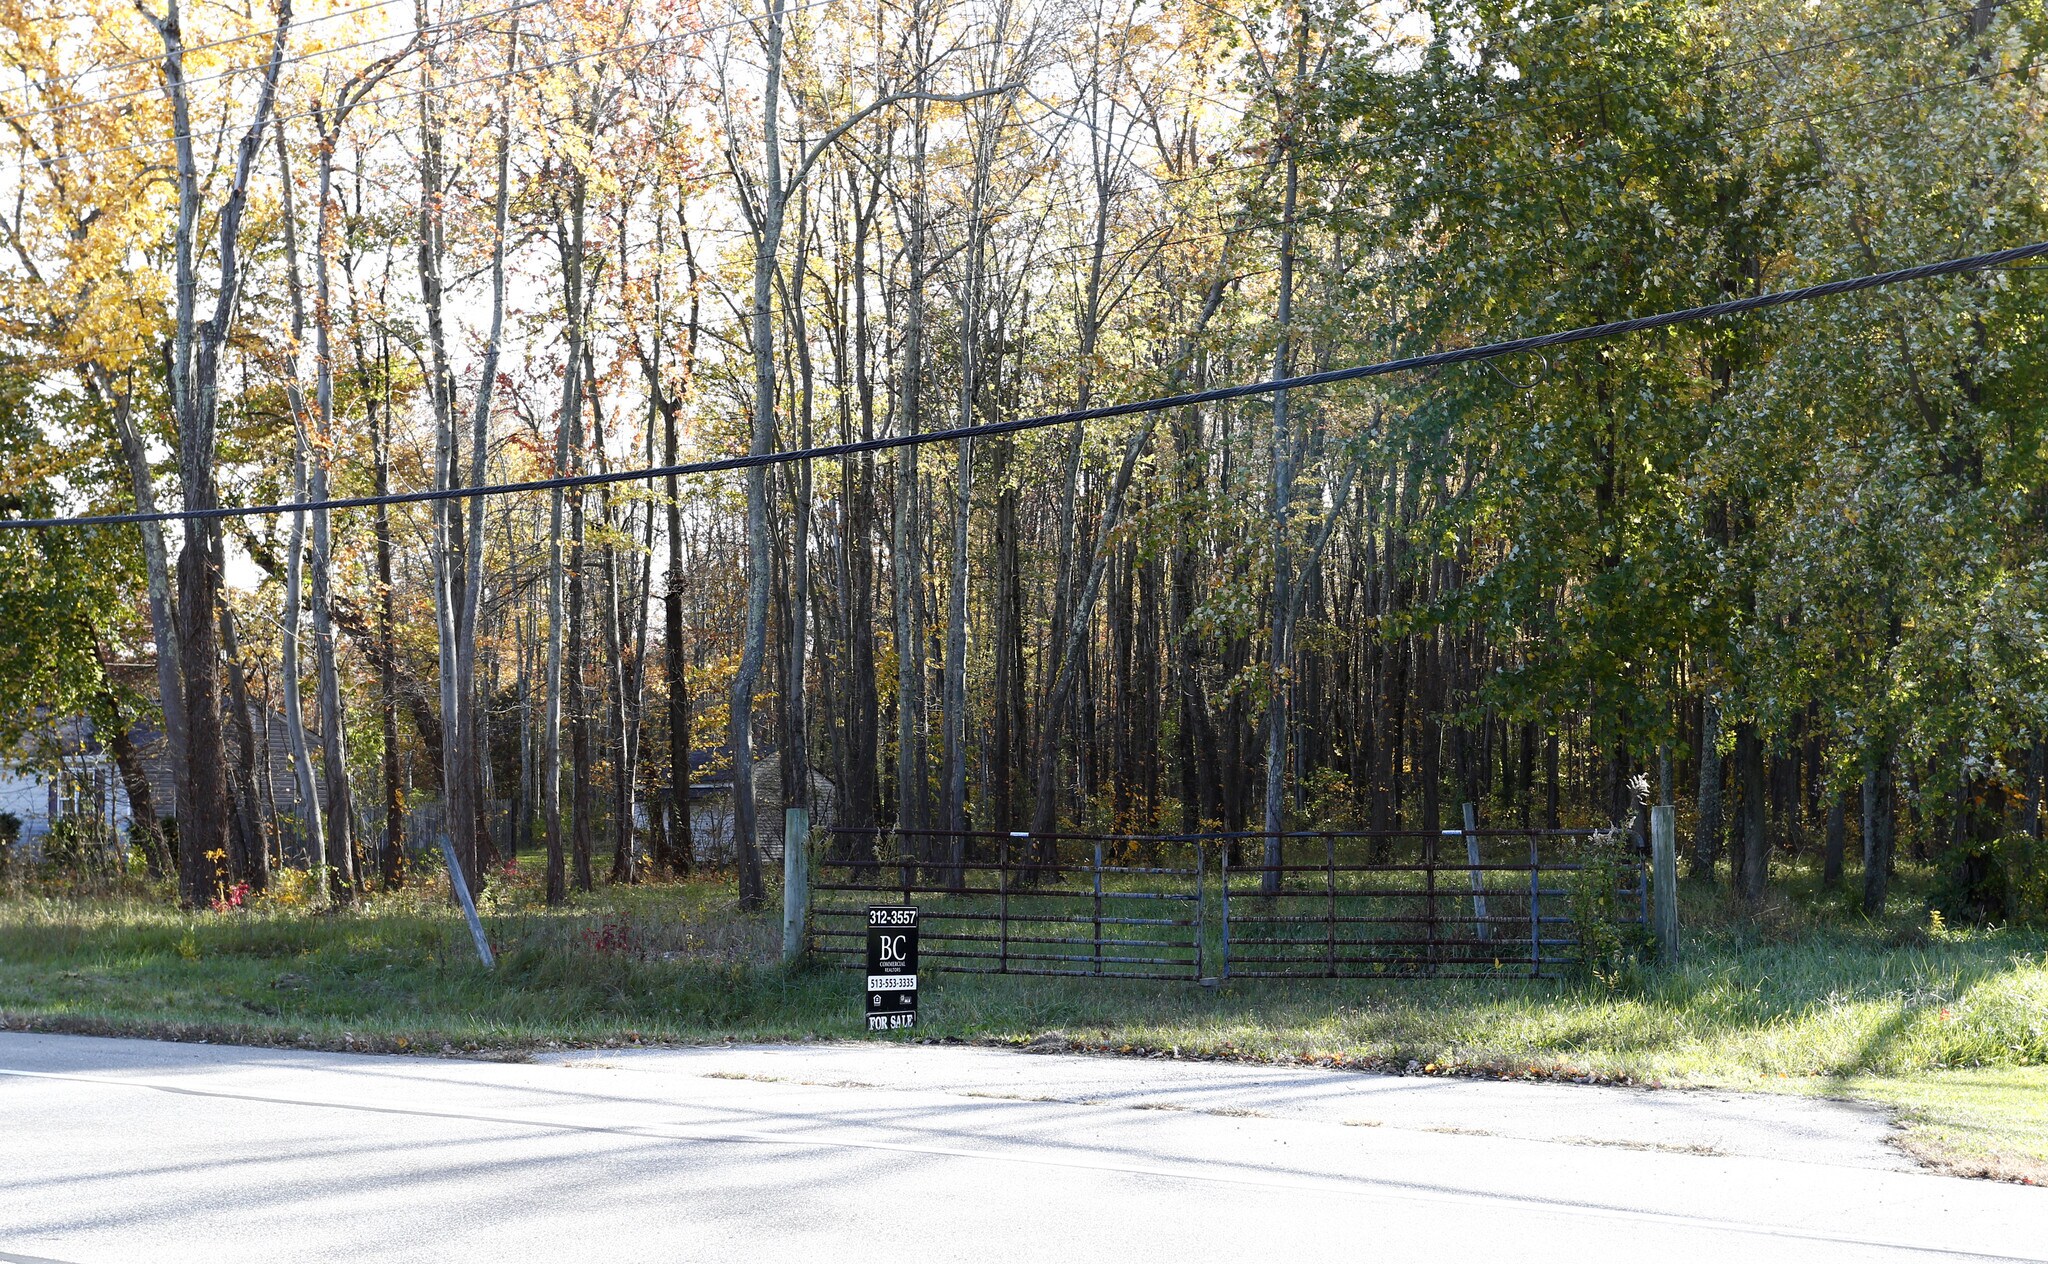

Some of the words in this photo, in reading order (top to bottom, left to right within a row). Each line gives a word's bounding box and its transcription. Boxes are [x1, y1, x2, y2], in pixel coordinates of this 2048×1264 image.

[870, 910, 916, 924] 312-3557
[880, 935, 906, 960] BC
[871, 978, 914, 988] 513-553-3335
[869, 1016, 888, 1030] FOR
[890, 1015, 913, 1029] SALE
